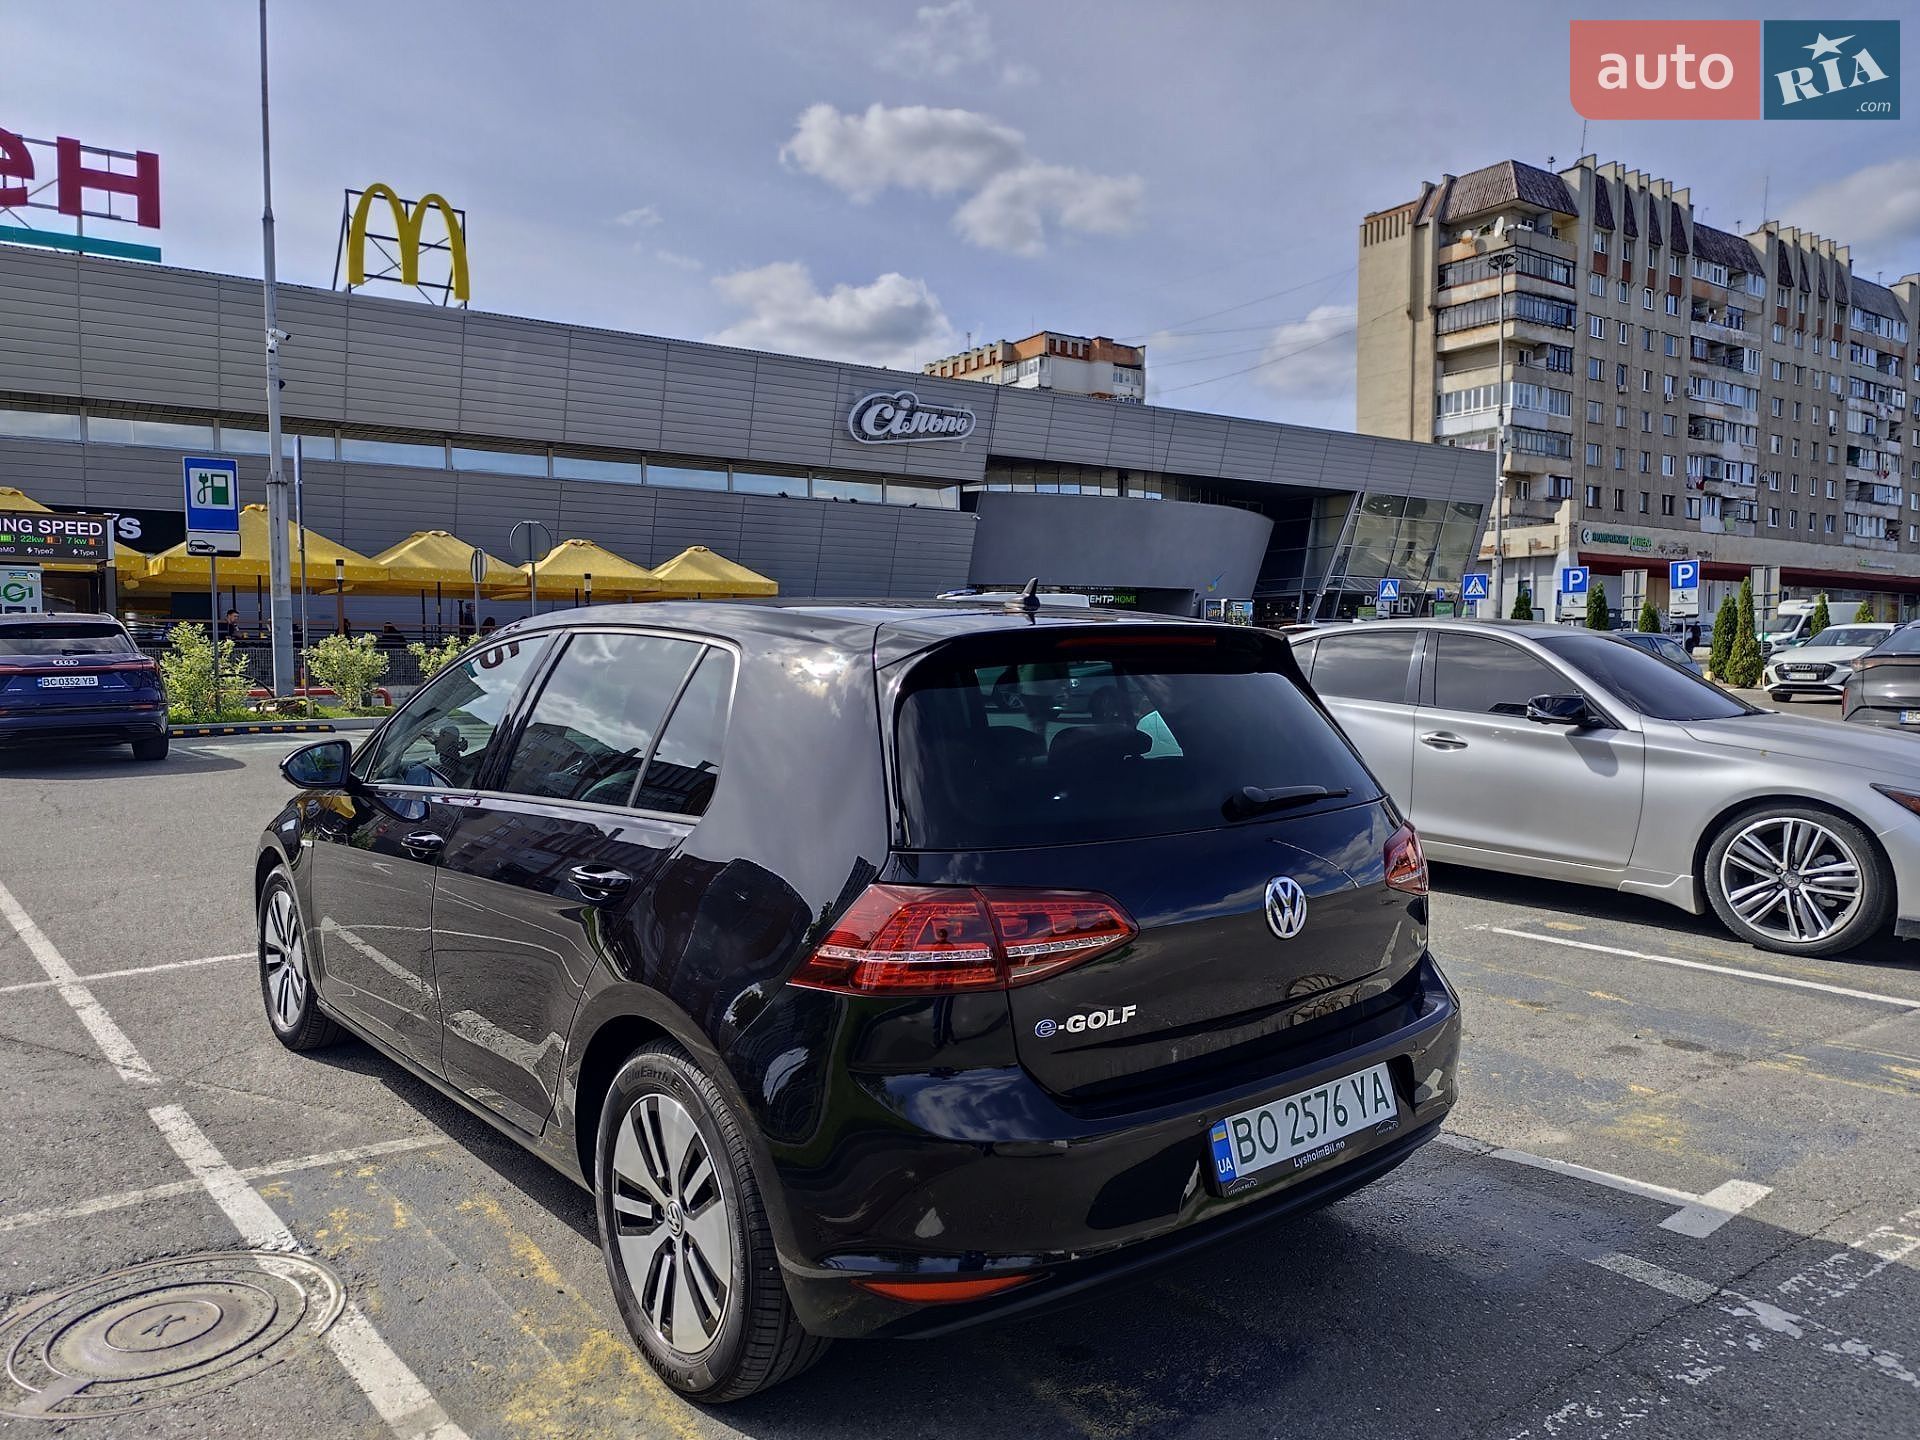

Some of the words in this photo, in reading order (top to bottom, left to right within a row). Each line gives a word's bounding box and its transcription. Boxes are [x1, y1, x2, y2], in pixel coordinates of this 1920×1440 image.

[38, 520, 103, 536] SPEED
[1569, 570, 1583, 592] P
[1677, 564, 1694, 587] P
[59, 678, 80, 686] 0352
[1034, 1004, 1137, 1038] e-GOLF
[1232, 1111, 1280, 1166] BO
[1285, 1093, 1349, 1148] 2576
[1350, 1070, 1391, 1121] YA
[1293, 1139, 1347, 1169] LysholmBil.no
[1217, 1157, 1234, 1174] UA
